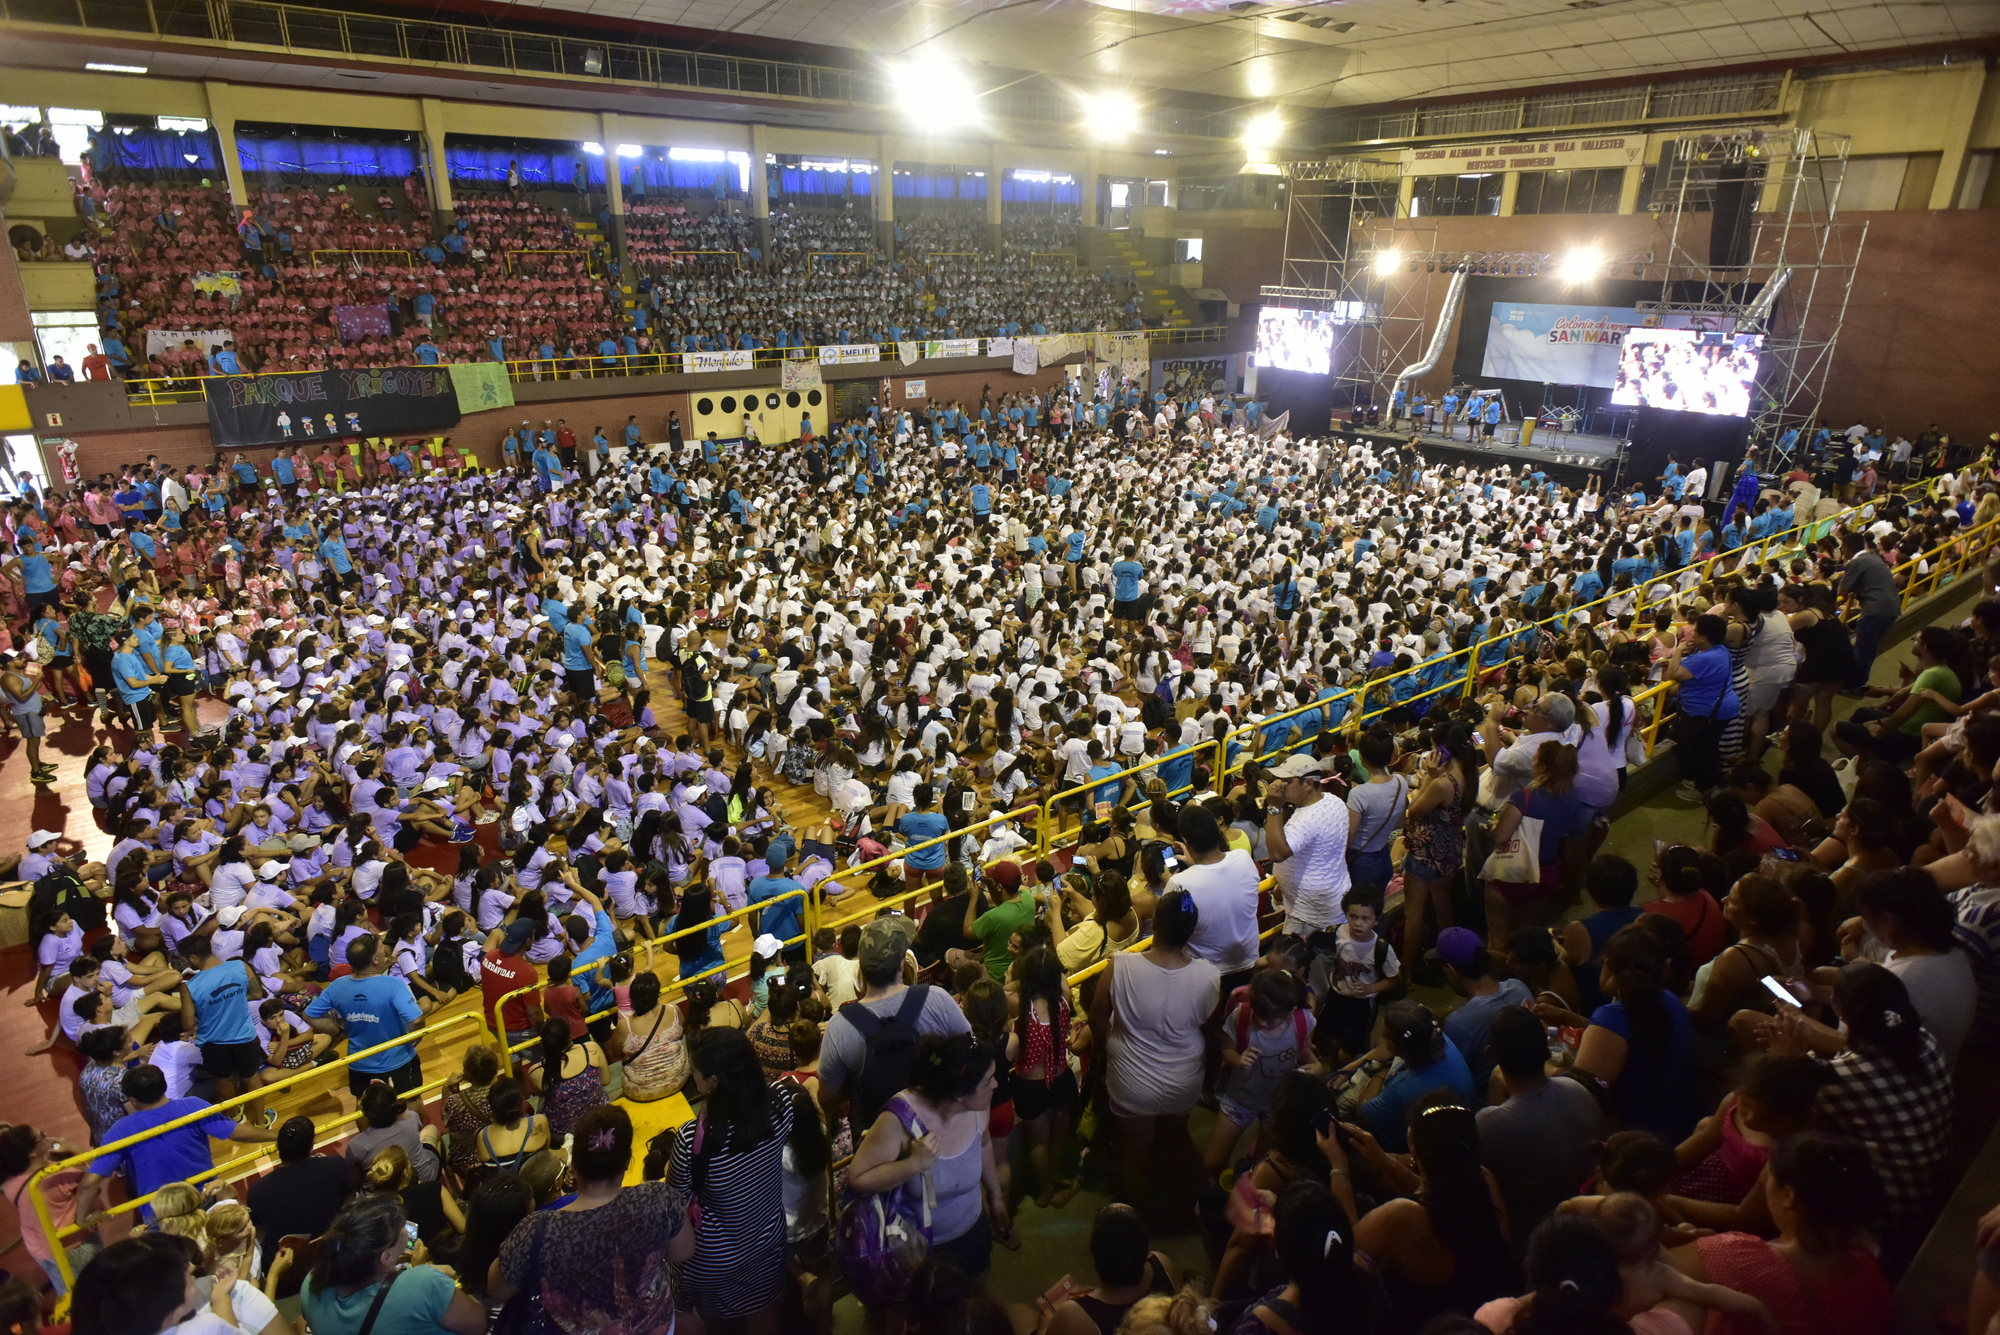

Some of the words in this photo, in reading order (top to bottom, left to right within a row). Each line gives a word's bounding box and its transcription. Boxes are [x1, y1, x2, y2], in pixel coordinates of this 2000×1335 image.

[1415, 149, 1446, 160] SOCIEDAD
[1449, 147, 1482, 159] ALEMANA
[1486, 147, 1496, 157] DE
[1499, 144, 1535, 156] GIMNASIA
[1538, 143, 1549, 153] DE
[1554, 141, 1575, 152] VILLA
[1581, 138, 1625, 151] BALLESTER
[1466, 159, 1506, 171] DEUTSCHER
[1509, 314, 1524, 322] 2019
[1555, 315, 1594, 330] Colonia
[1594, 316, 1606, 331] de
[1549, 329, 1582, 343] SAN
[226, 376, 328, 408] PARQUE
